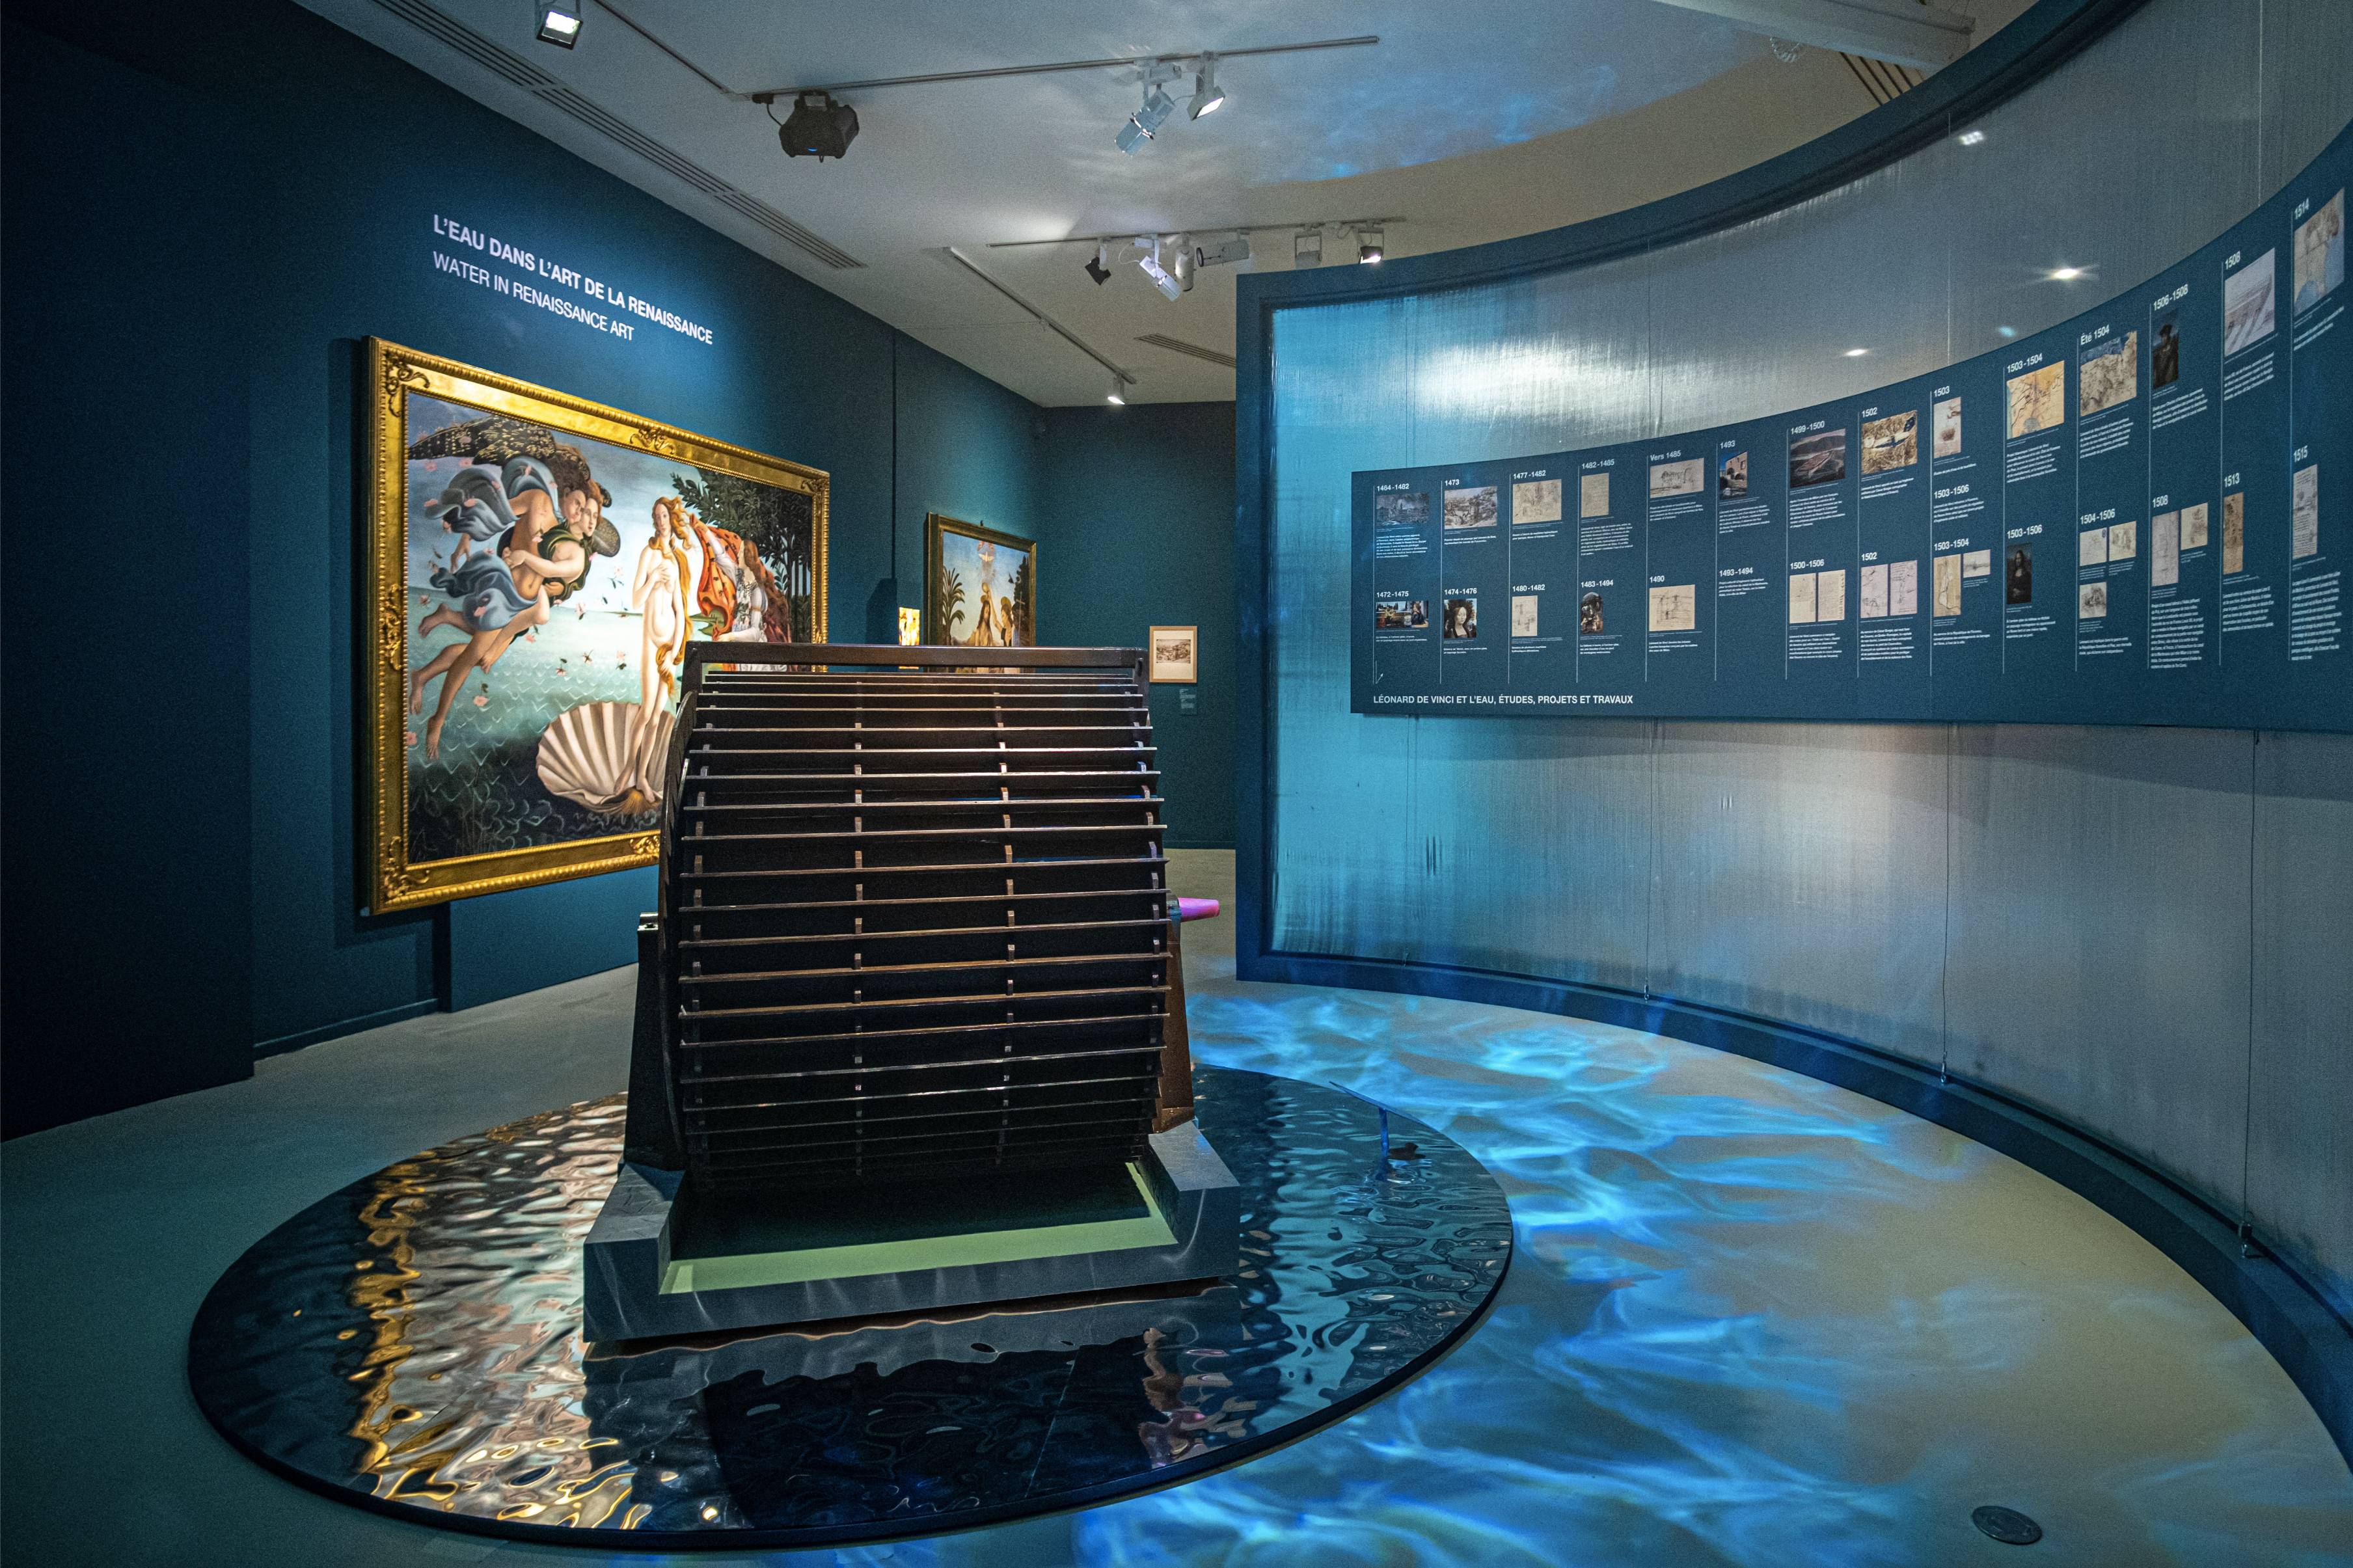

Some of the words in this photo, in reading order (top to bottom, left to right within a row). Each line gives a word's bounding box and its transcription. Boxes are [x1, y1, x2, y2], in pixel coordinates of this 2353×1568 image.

[433, 214, 484, 251] L'EAU
[489, 237, 536, 271] DANS
[539, 258, 581, 290] L'ART
[584, 278, 605, 300] DE
[608, 287, 625, 308] LA
[628, 295, 713, 345] RENAISSANCE
[433, 250, 490, 288] WATER
[494, 275, 510, 295] IN
[513, 282, 608, 332] RENAISSANCE
[610, 321, 635, 342] ART
[2080, 332, 2093, 345] Été
[2093, 324, 2110, 339] 1504
[1933, 386, 1950, 398] 1503
[1862, 407, 1878, 418] 1502
[1720, 440, 1735, 449] 1493
[1650, 453, 1665, 461] Vers
[1666, 450, 1681, 458] 1485
[2293, 445, 2308, 463] 1515
[1513, 470, 1546, 480] 1477-1482
[2224, 472, 2240, 488] 1513
[2153, 494, 2168, 508] 1508
[1861, 552, 1877, 561] 1502
[1719, 567, 1754, 577] 1493-1494
[1373, 694, 1415, 704] LÉONARD
[1417, 696, 1429, 704] DE
[1430, 696, 1454, 704] VINCI
[1469, 696, 1497, 705] L'EAU,
[1499, 694, 1536, 705] ÉTUDES,
[1538, 696, 1577, 704] PROJETS
[1579, 696, 1591, 704] ET
[1593, 695, 1633, 704] TRAVAUX
